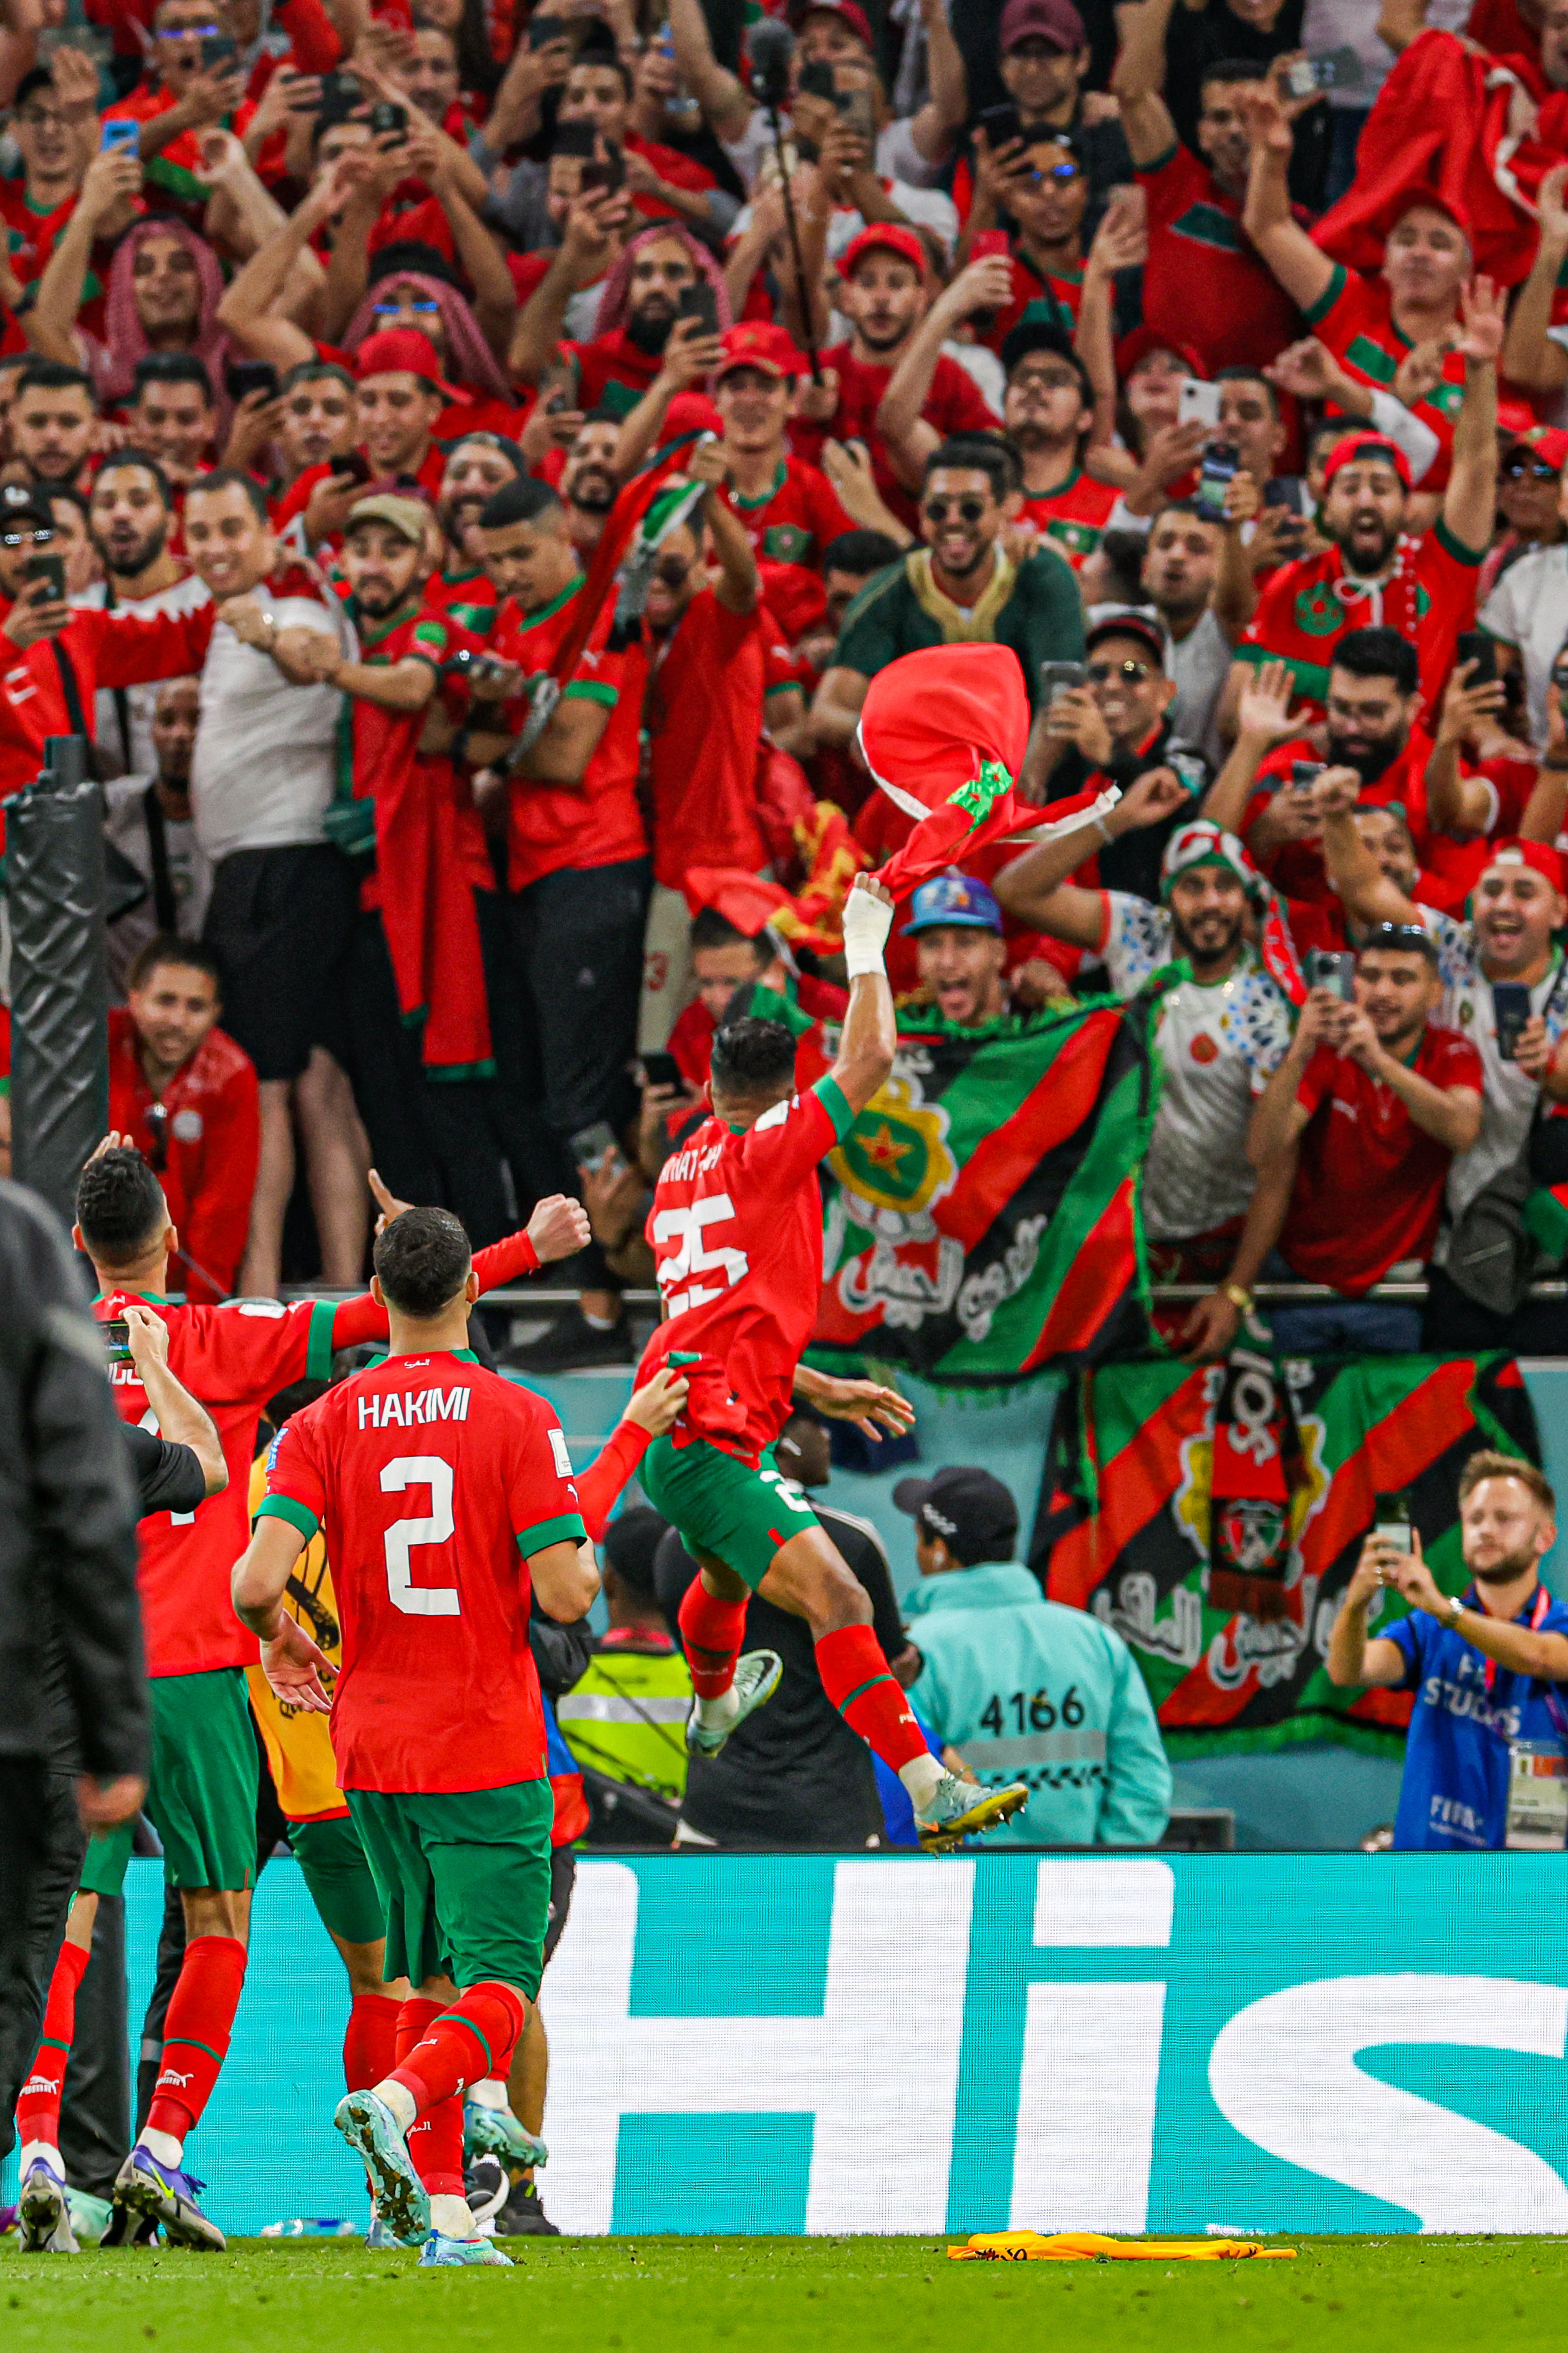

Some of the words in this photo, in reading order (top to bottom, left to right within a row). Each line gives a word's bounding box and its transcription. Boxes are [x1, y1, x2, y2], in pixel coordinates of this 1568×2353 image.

[653, 1193, 749, 1320] 25
[358, 1386, 471, 1430] HAKIMI
[379, 1456, 461, 1616] 2
[979, 1685, 1085, 1737] 4166
